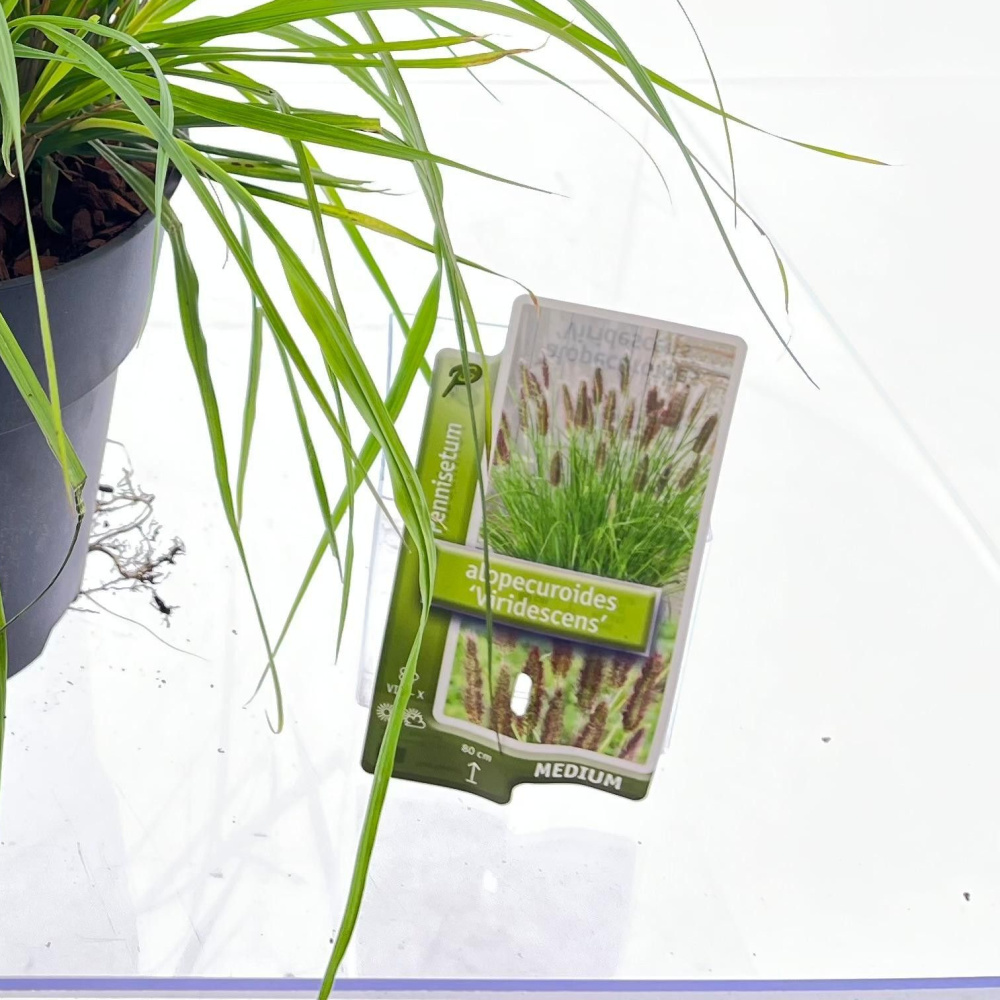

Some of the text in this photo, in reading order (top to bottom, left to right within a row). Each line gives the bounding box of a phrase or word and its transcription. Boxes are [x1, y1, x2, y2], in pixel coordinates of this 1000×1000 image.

[465, 562, 618, 612] alopecuroides
[460, 743, 493, 763] 80 cm
[533, 762, 623, 791] MEDIUM
